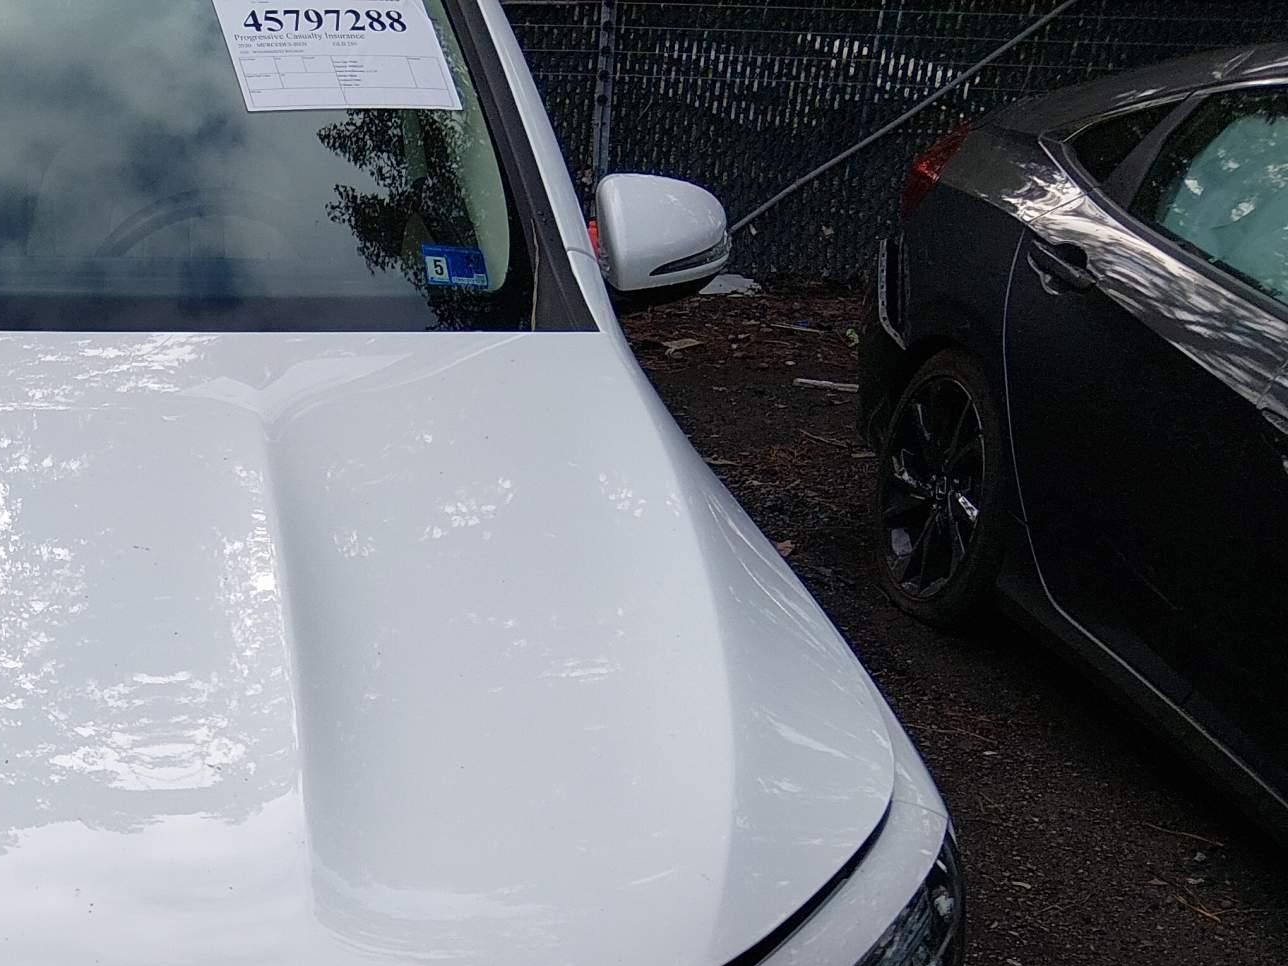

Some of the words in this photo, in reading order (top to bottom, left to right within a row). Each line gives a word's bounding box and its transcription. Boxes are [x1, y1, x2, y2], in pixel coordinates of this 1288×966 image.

[243, 9, 407, 32] 45797288
[234, 33, 284, 41] Progressive
[286, 32, 322, 40] Casualty
[325, 32, 365, 40] Insurance
[433, 259, 444, 276] 5
